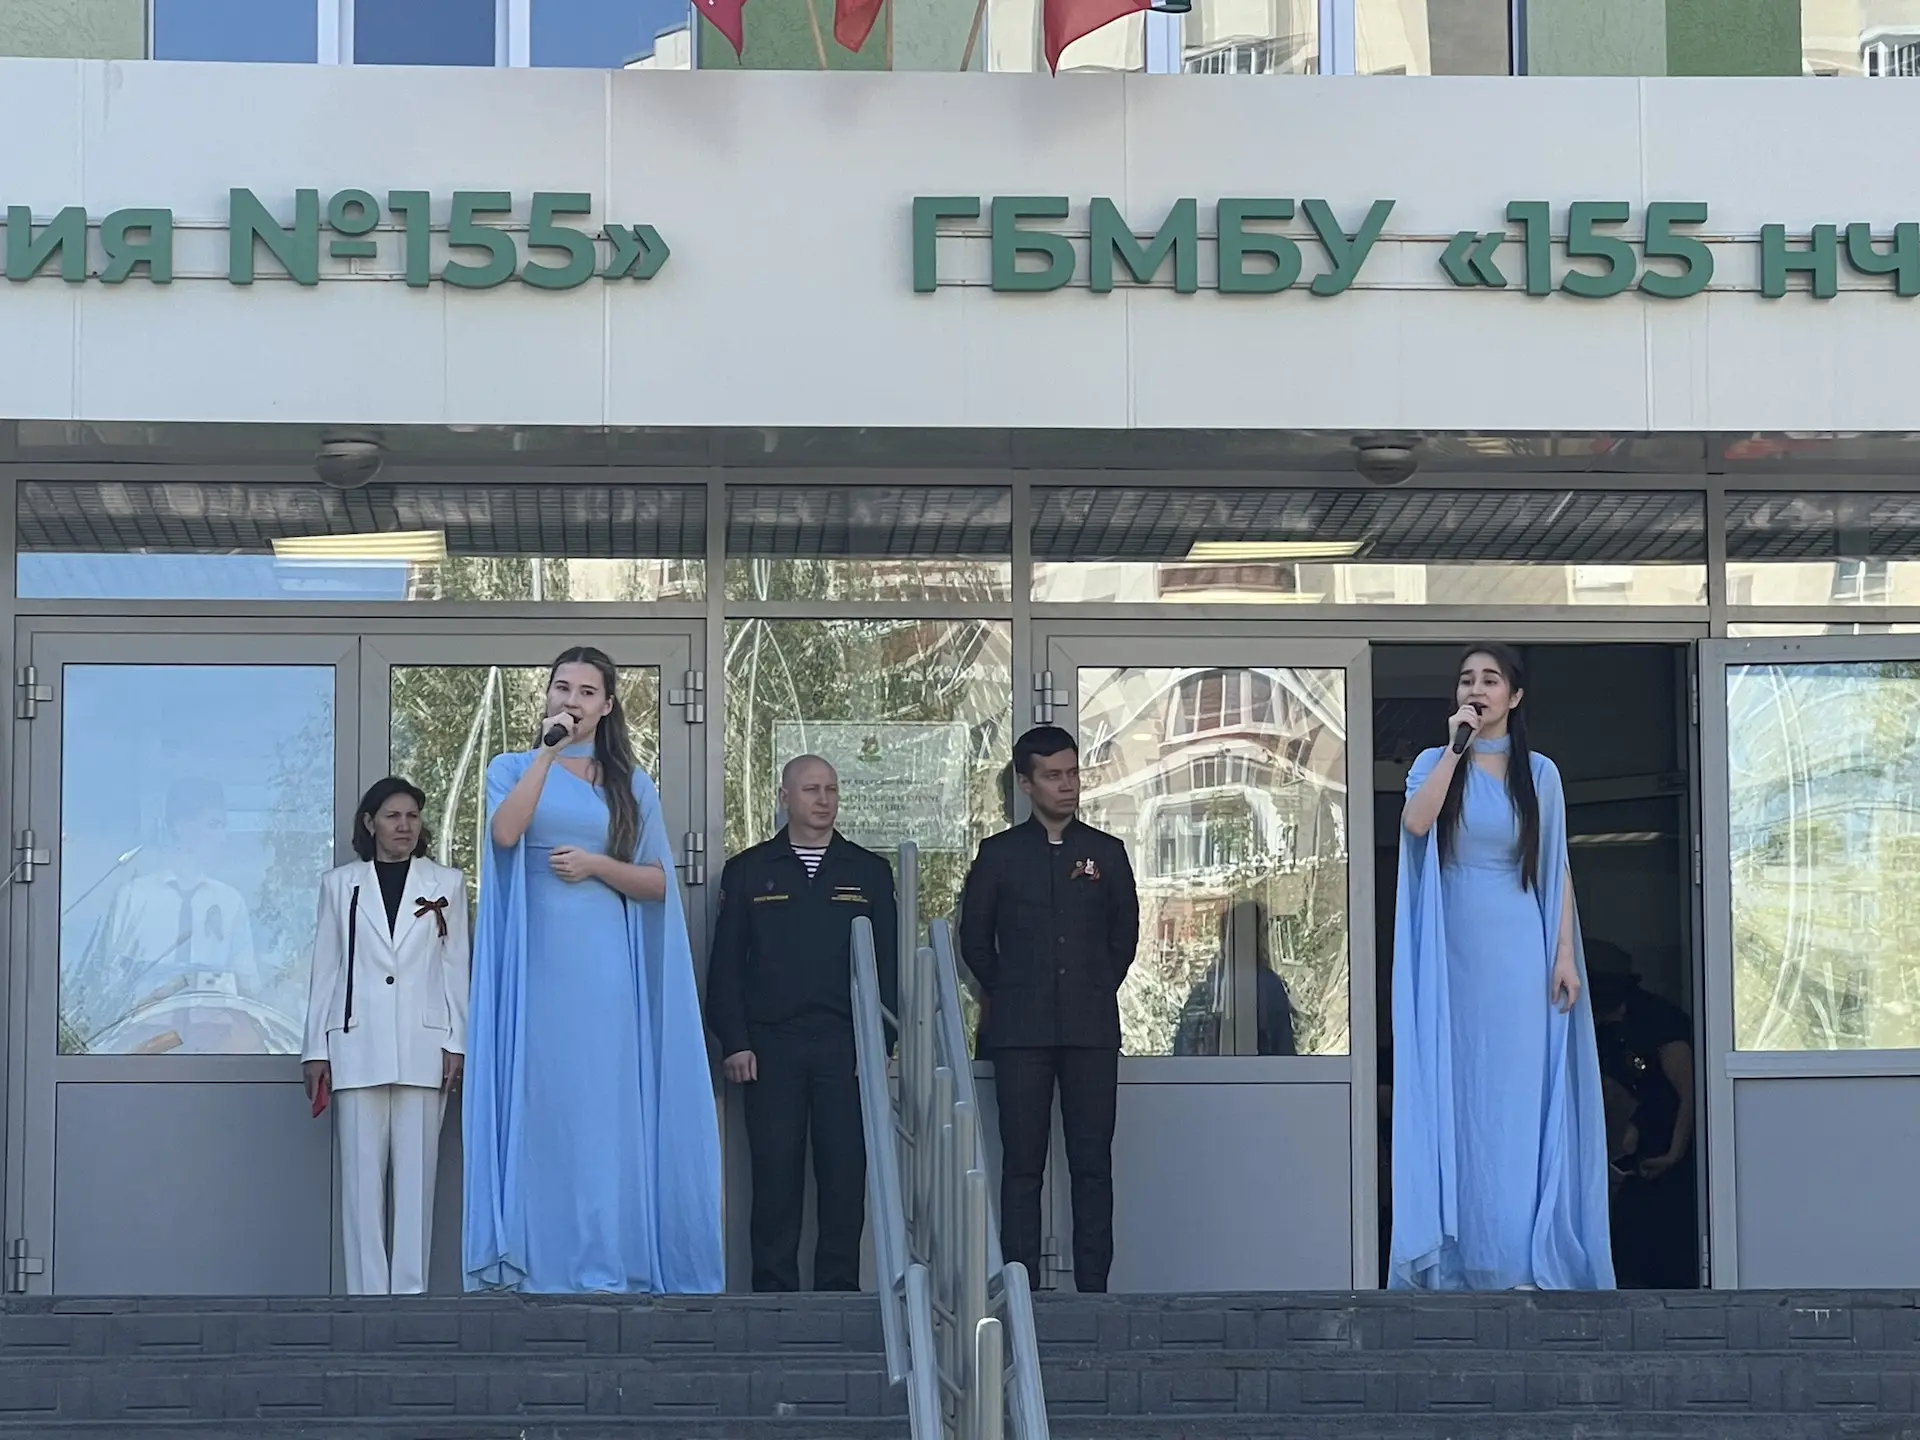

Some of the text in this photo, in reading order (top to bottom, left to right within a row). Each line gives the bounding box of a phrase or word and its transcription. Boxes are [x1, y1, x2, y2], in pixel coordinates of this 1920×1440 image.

[228, 187, 671, 291] №155»
[911, 194, 1396, 297] ГБМБУ
[1438, 200, 1715, 299] «155
